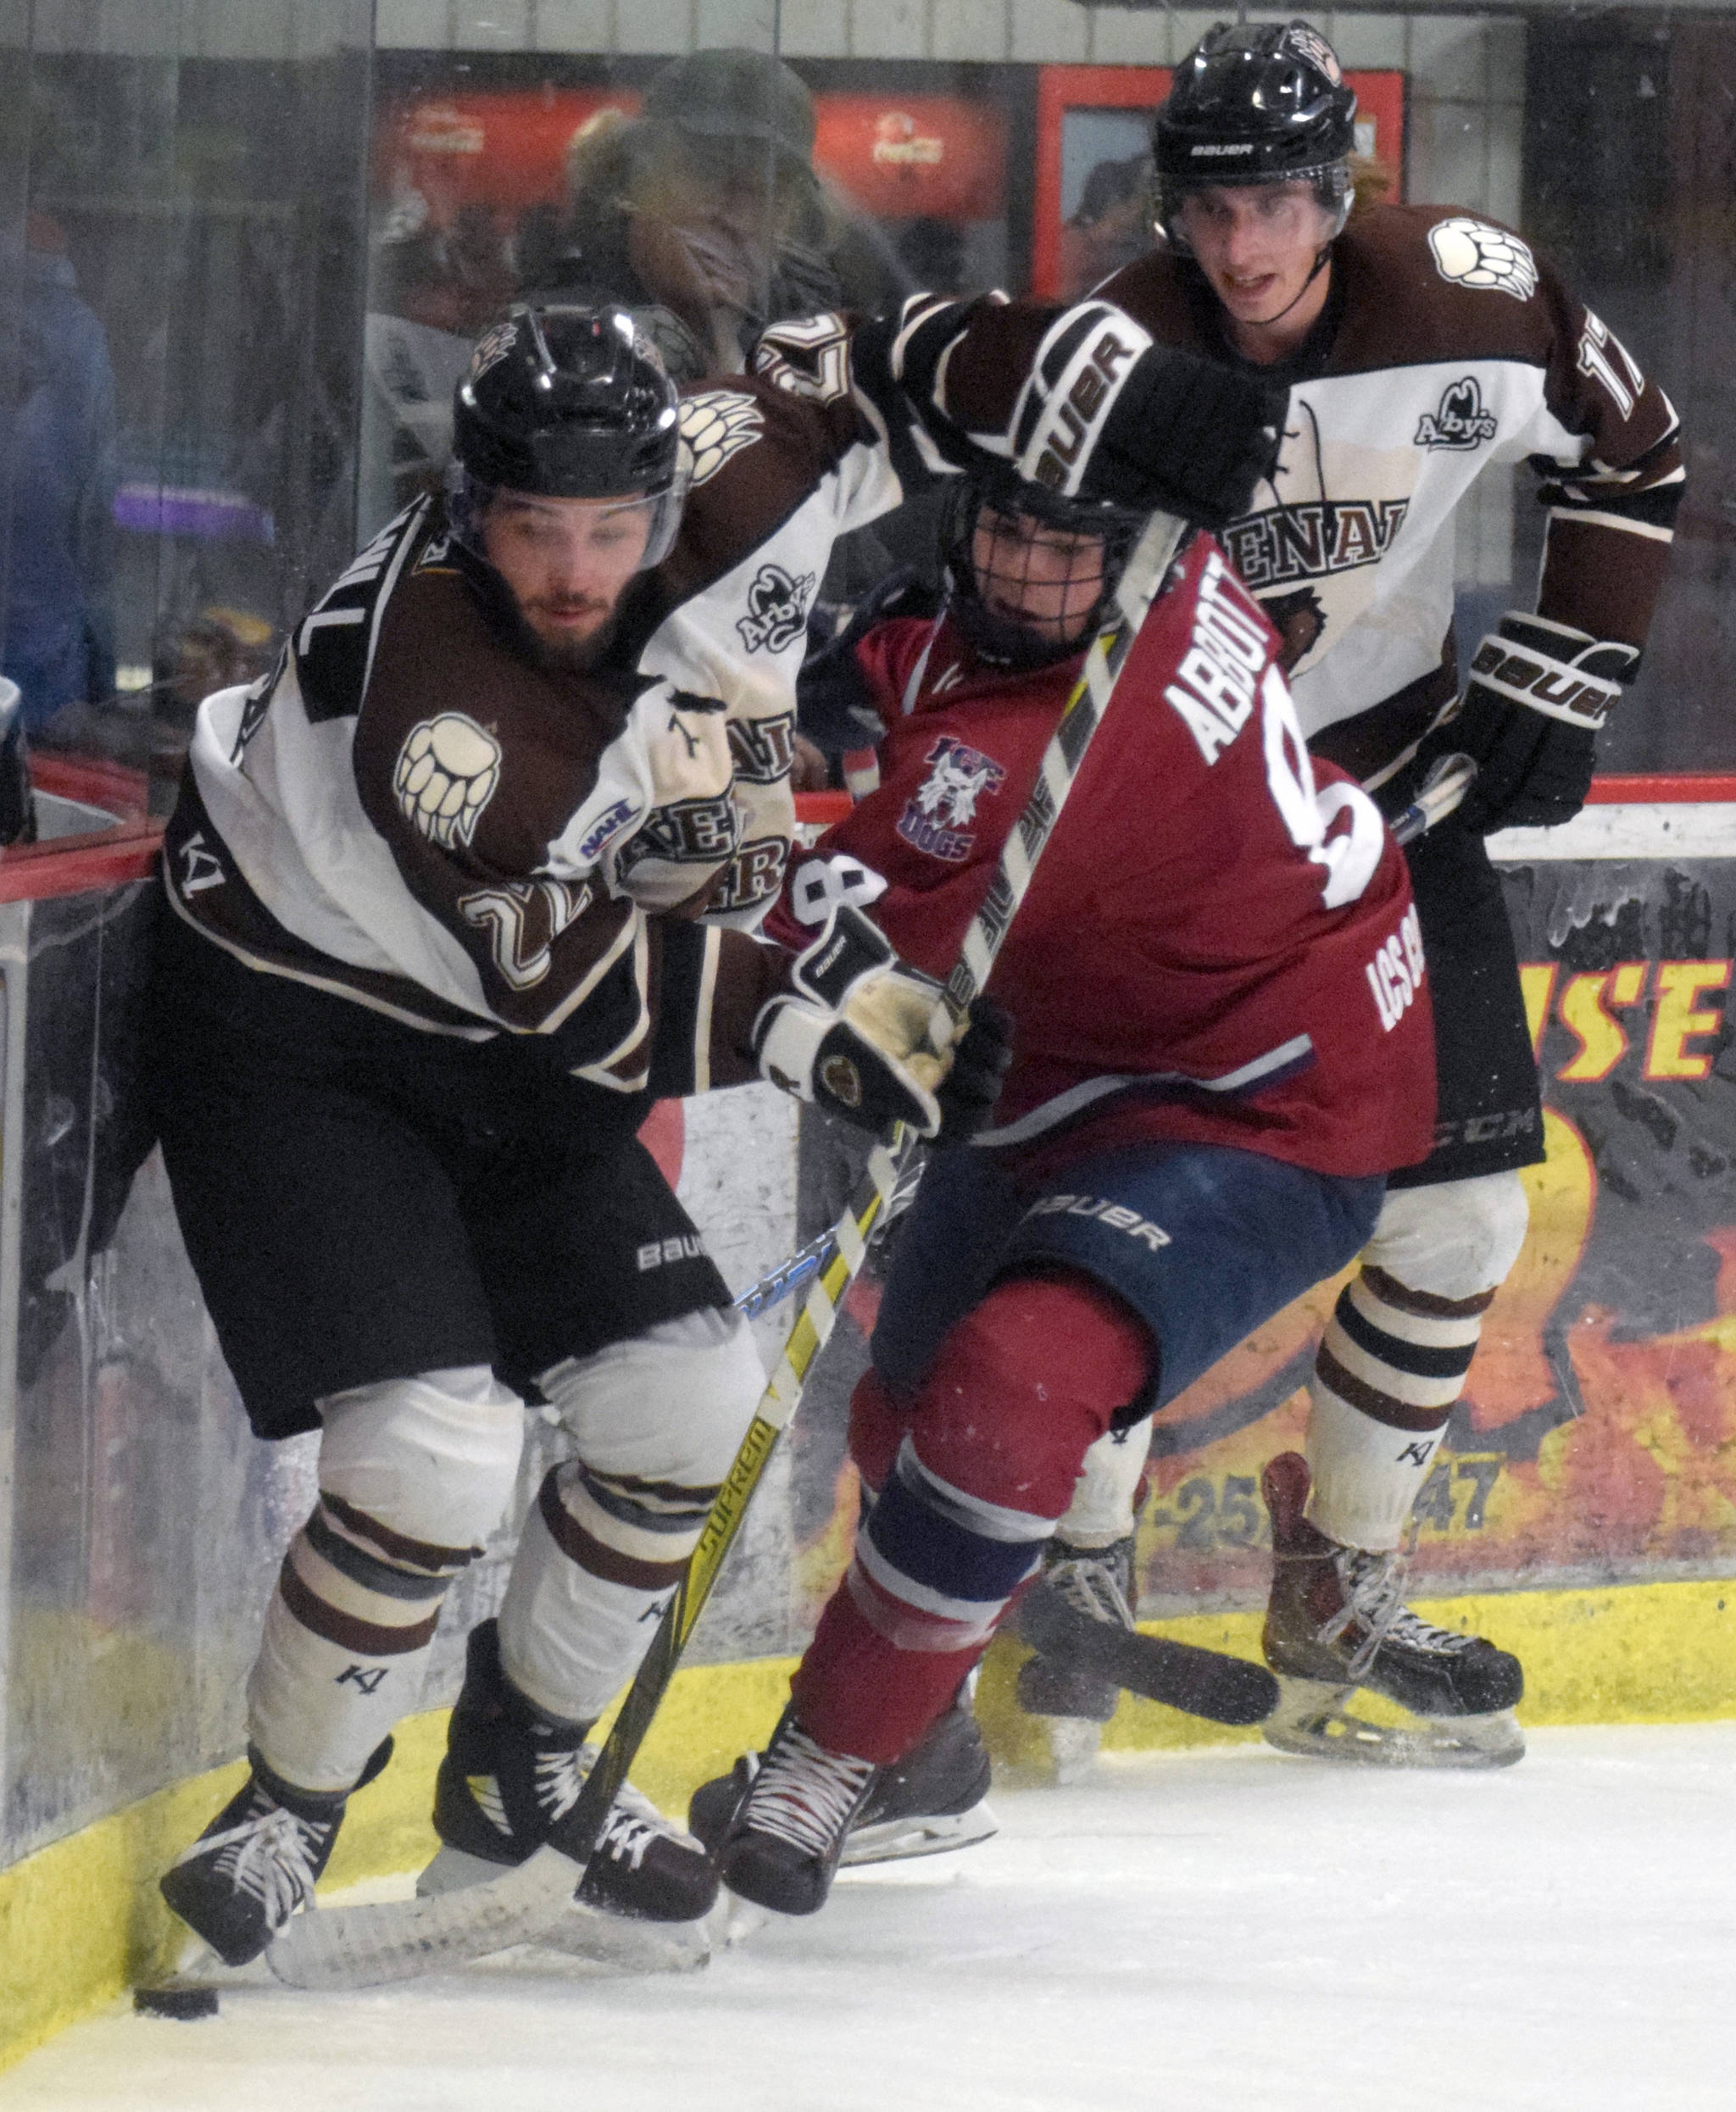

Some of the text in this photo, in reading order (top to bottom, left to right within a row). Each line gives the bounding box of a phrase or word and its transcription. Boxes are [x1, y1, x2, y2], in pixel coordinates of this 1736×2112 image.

[1191, 143, 1253, 156] BAUER
[1577, 303, 1645, 422] 17
[1034, 331, 1134, 492] AUER
[1222, 500, 1411, 586] ENAI
[1163, 551, 1271, 766] ABBOTT
[580, 804, 637, 859] NAHL
[896, 798, 976, 862] DOGS
[815, 935, 847, 978] BAUER
[637, 1234, 702, 1271] BAU
